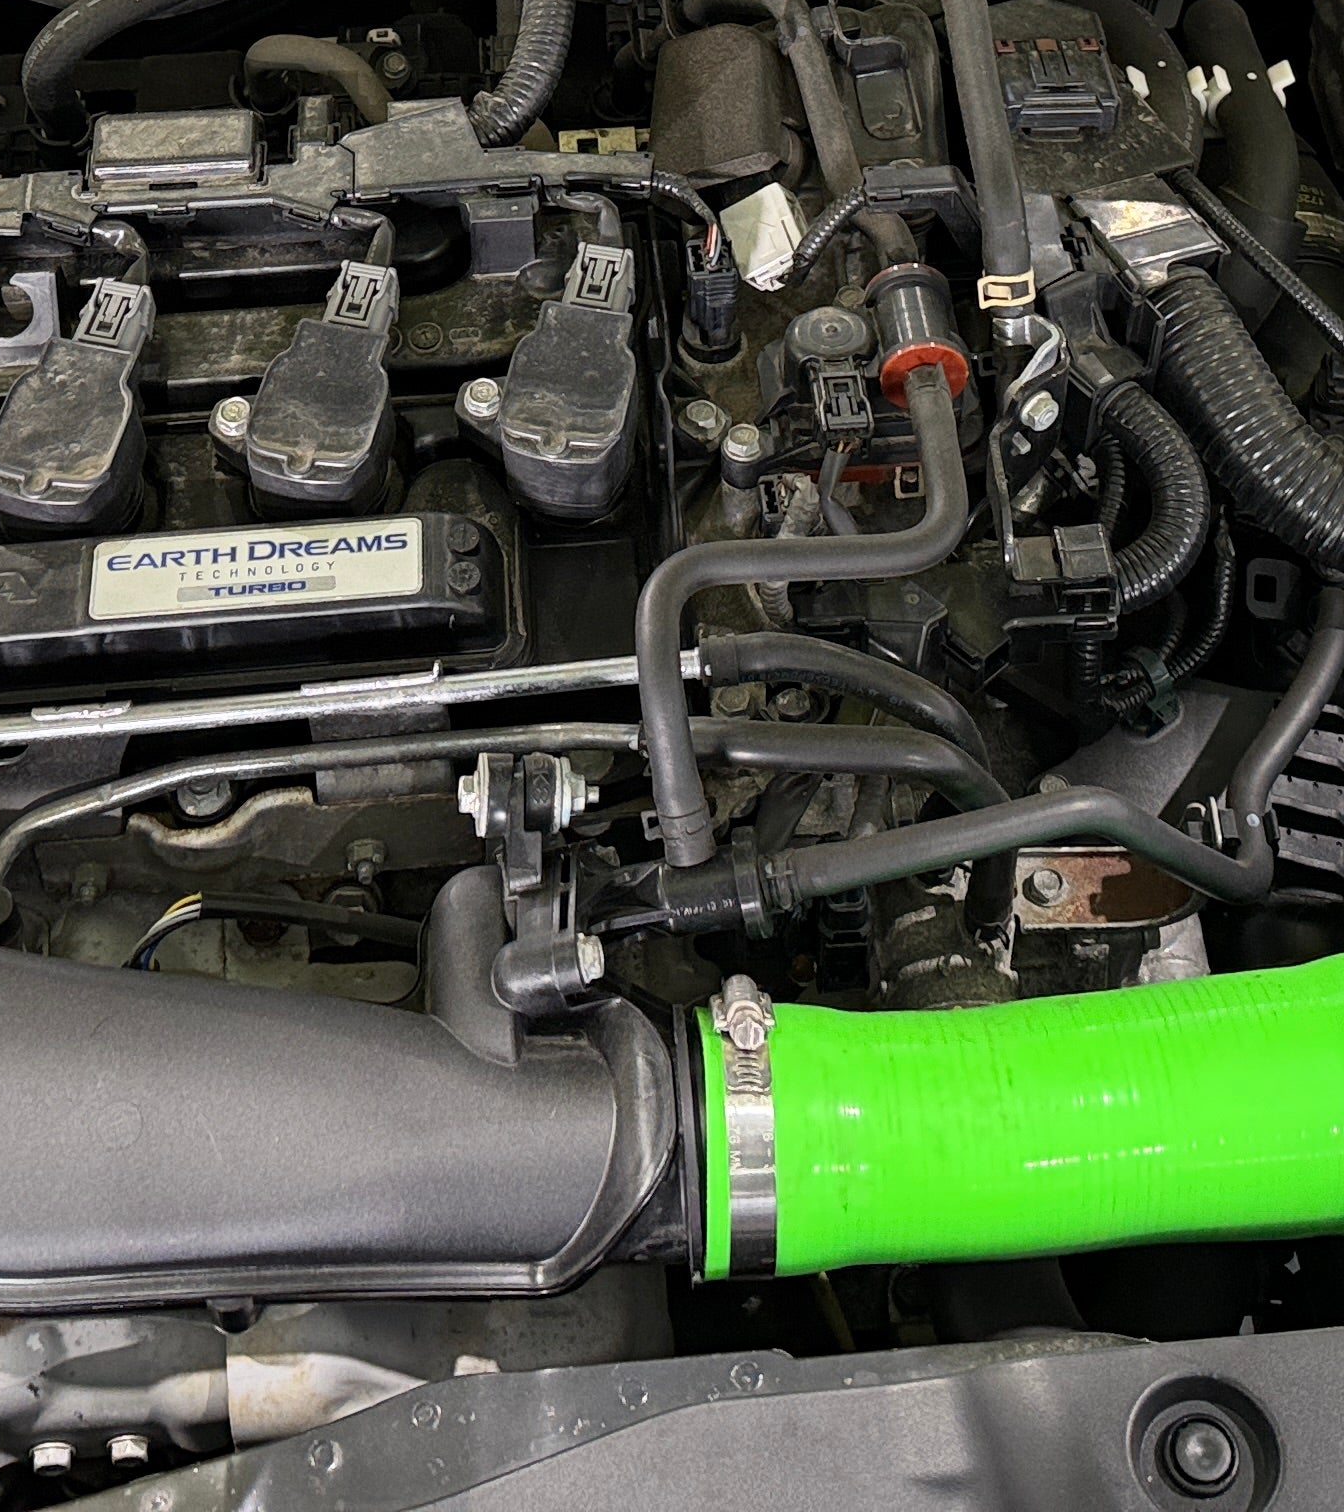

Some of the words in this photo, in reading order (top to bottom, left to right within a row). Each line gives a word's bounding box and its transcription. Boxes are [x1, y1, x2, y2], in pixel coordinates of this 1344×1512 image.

[107, 546, 237, 571] EARTH
[247, 533, 408, 561] DREAMS
[179, 561, 336, 581] TECHNOLOGY
[208, 580, 306, 597] TURBO
